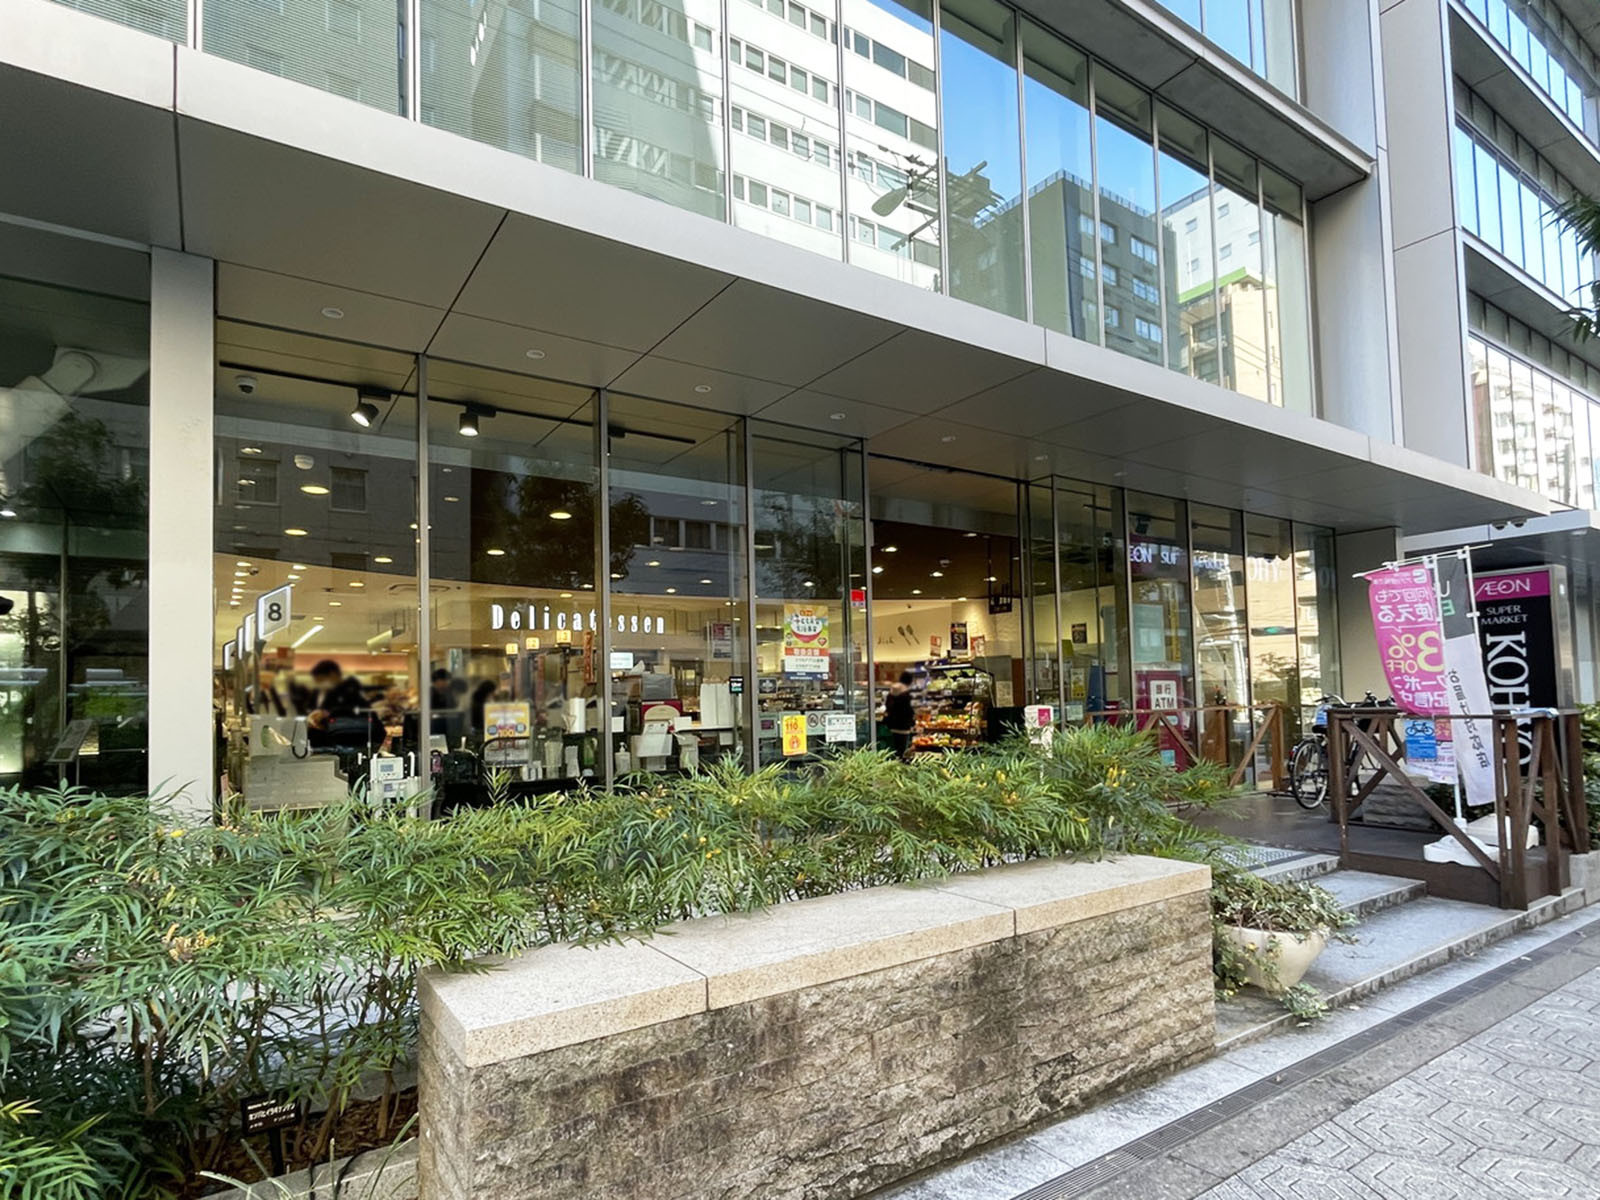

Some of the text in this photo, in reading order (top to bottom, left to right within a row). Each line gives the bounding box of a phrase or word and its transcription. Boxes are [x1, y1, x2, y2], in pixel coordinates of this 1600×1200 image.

[267, 602, 283, 622] 8
[1486, 604, 1522, 616] SUPER
[491, 604, 665, 635] Delicatssen
[1480, 613, 1529, 625] MARKET
[1154, 697, 1175, 709] ATM
